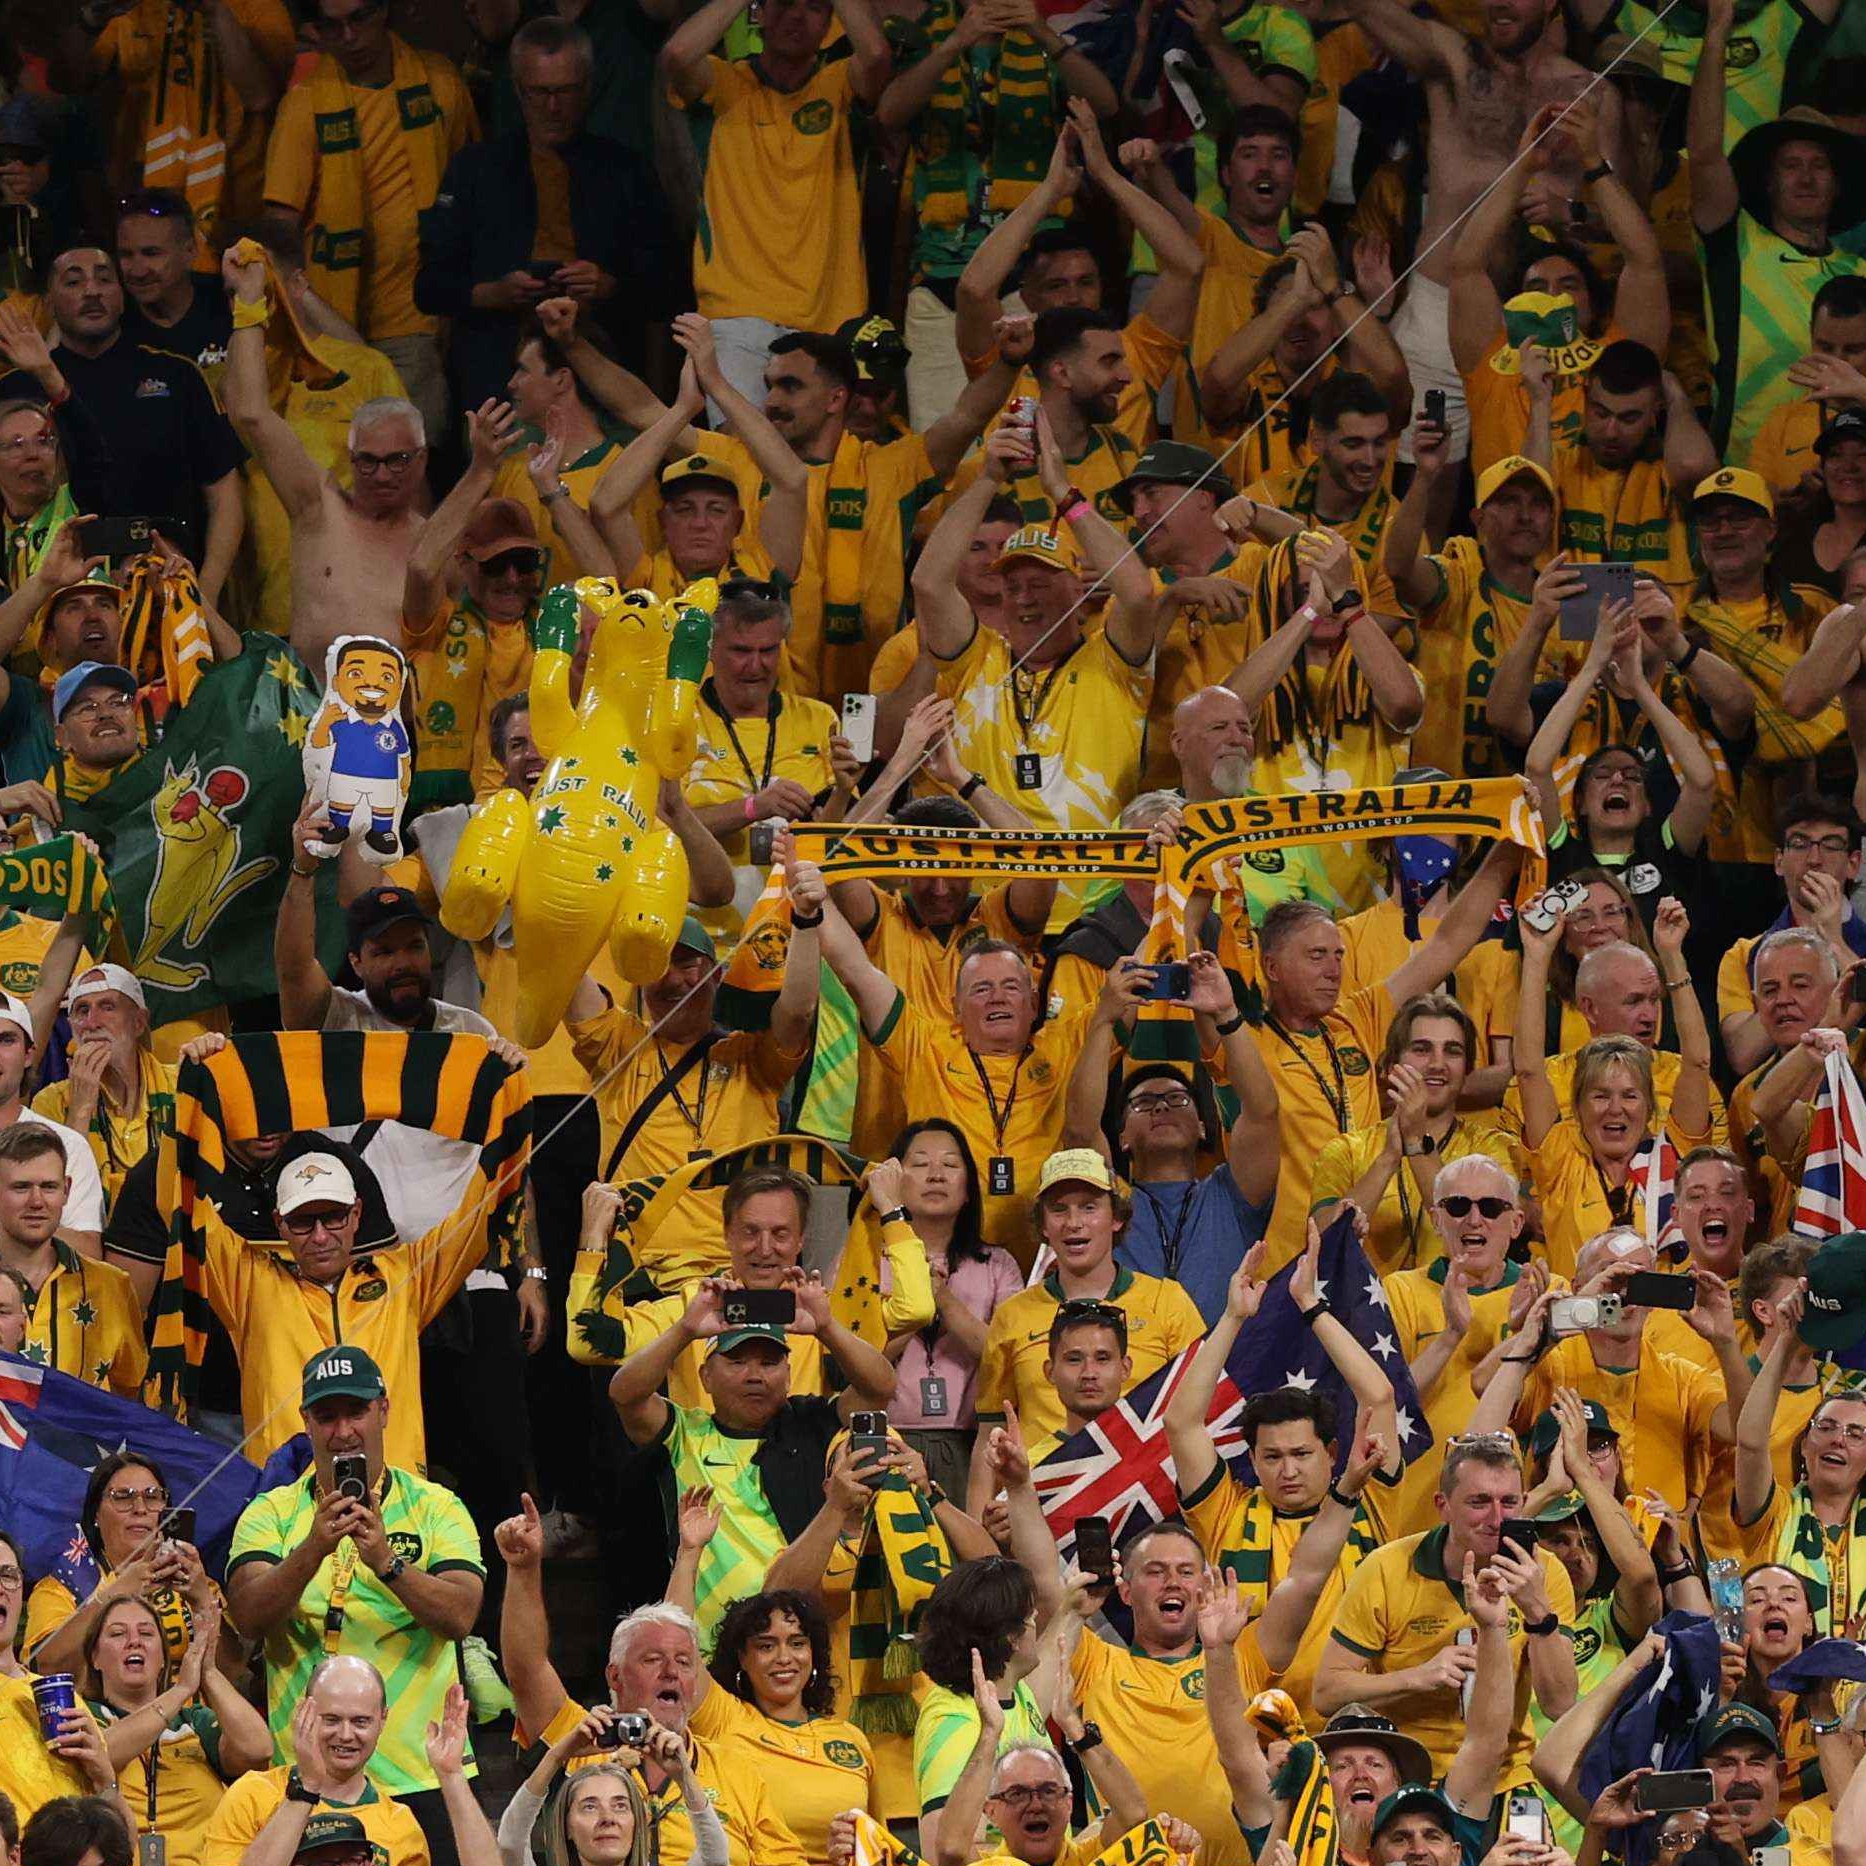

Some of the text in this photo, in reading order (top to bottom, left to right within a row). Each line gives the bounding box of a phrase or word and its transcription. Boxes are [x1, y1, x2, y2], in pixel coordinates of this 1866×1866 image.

[537, 776, 589, 800] AUST
[1178, 781, 1475, 853] AUSTRALIA
[888, 828, 957, 838] GREEN
[990, 831, 1045, 841] GOLD
[1053, 833, 1108, 842] ARMY
[1238, 831, 1275, 843] 2026
[1323, 819, 1376, 832] WORLD
[1383, 816, 1413, 826] CUP
[824, 836, 1159, 863] AUSTRALIA
[899, 860, 941, 868] 2026
[998, 863, 1059, 873] WORLD
[1067, 865, 1100, 873] CUP
[316, 1359, 354, 1381] AUS
